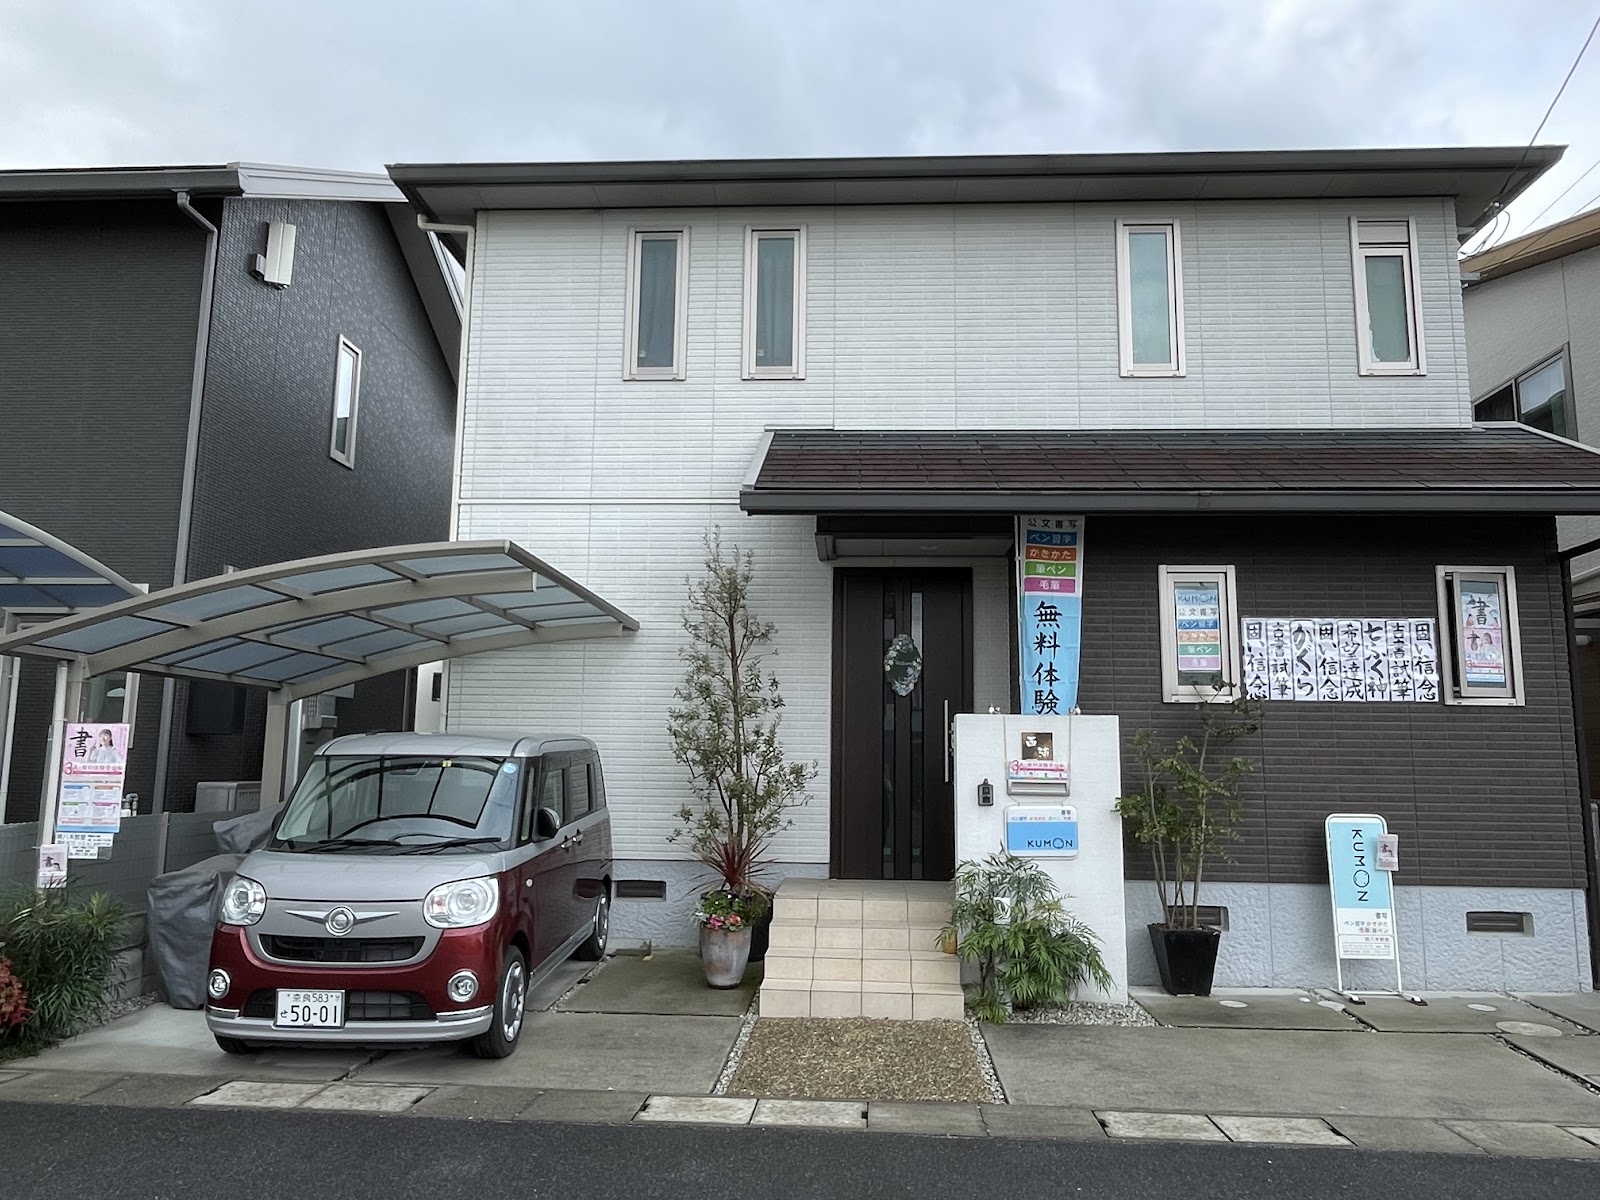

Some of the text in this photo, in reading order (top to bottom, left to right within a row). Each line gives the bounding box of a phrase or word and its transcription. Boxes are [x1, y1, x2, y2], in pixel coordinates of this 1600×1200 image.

[1029, 548, 1072, 559] かきかた
[1036, 563, 1067, 574] 筆ペン
[1039, 579, 1061, 590] 毛筆
[1471, 596, 1490, 625] 書
[1031, 600, 1063, 715] 無料体験
[1245, 622, 1268, 700] 固い信念
[1292, 622, 1314, 697] かぐら
[1318, 622, 1340, 700] 固い信念
[1341, 622, 1364, 700] 希望達成
[1364, 622, 1388, 699] 七ふく神
[1413, 622, 1437, 700] 固い信念
[69, 726, 94, 758] 書
[1027, 837, 1073, 850] KUMON
[1351, 829, 1370, 902] KUMON
[290, 1005, 337, 1023] 50-01
